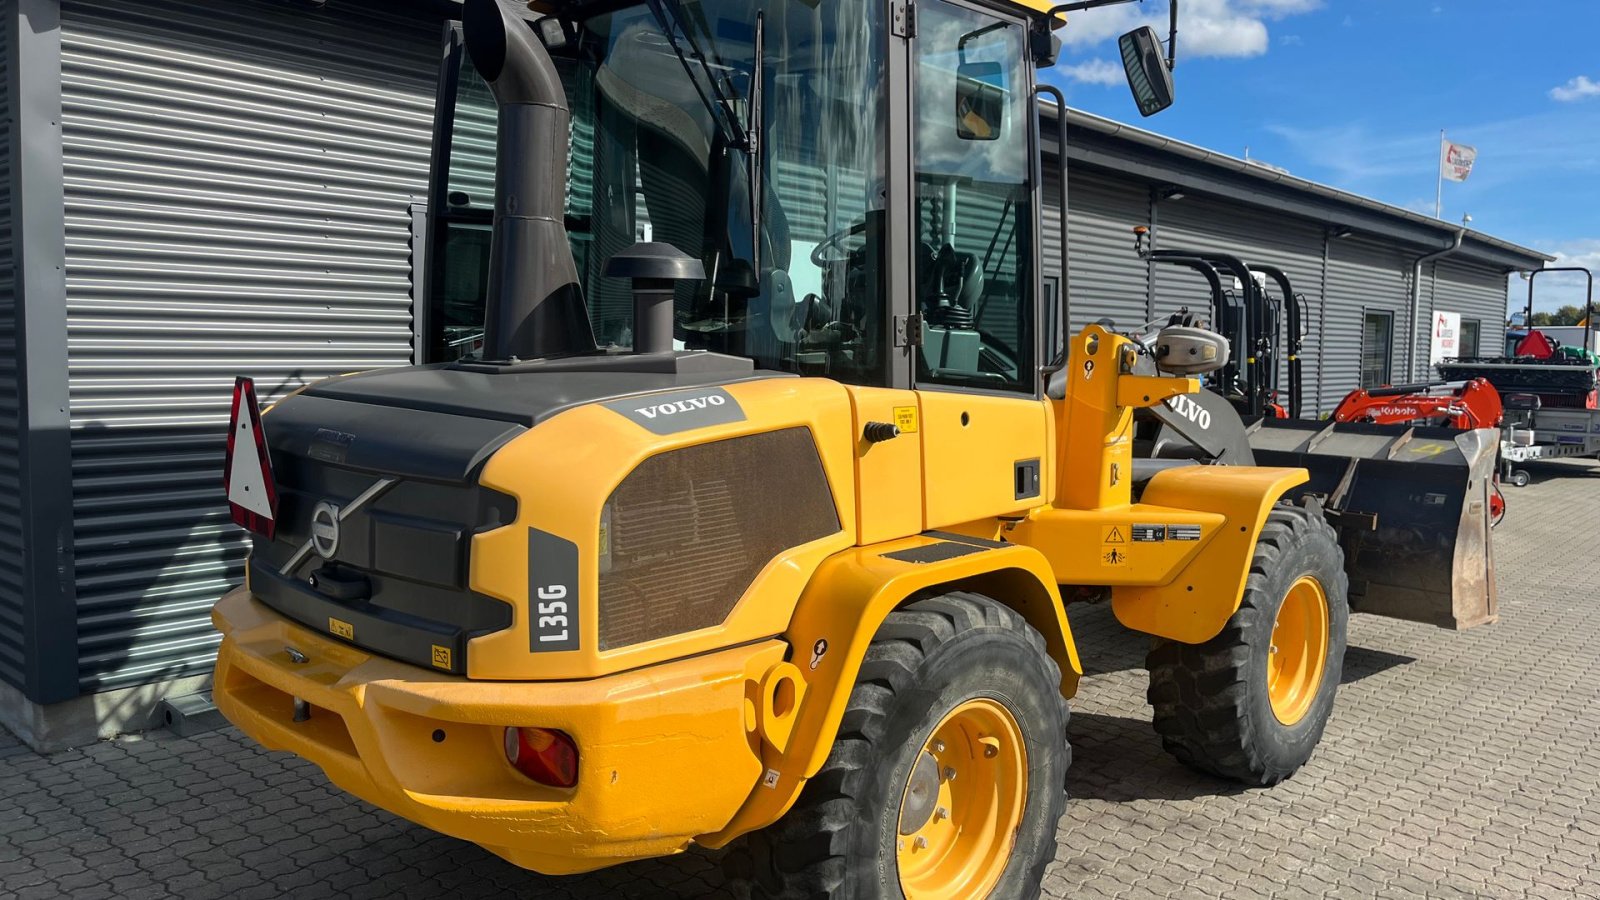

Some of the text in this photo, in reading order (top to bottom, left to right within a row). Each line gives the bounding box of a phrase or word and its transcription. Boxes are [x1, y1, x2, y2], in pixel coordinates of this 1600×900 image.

[635, 395, 725, 418] VOLVO
[1166, 394, 1211, 430] LVO
[1381, 406, 1416, 415] Kubota
[538, 585, 568, 641] L35G
